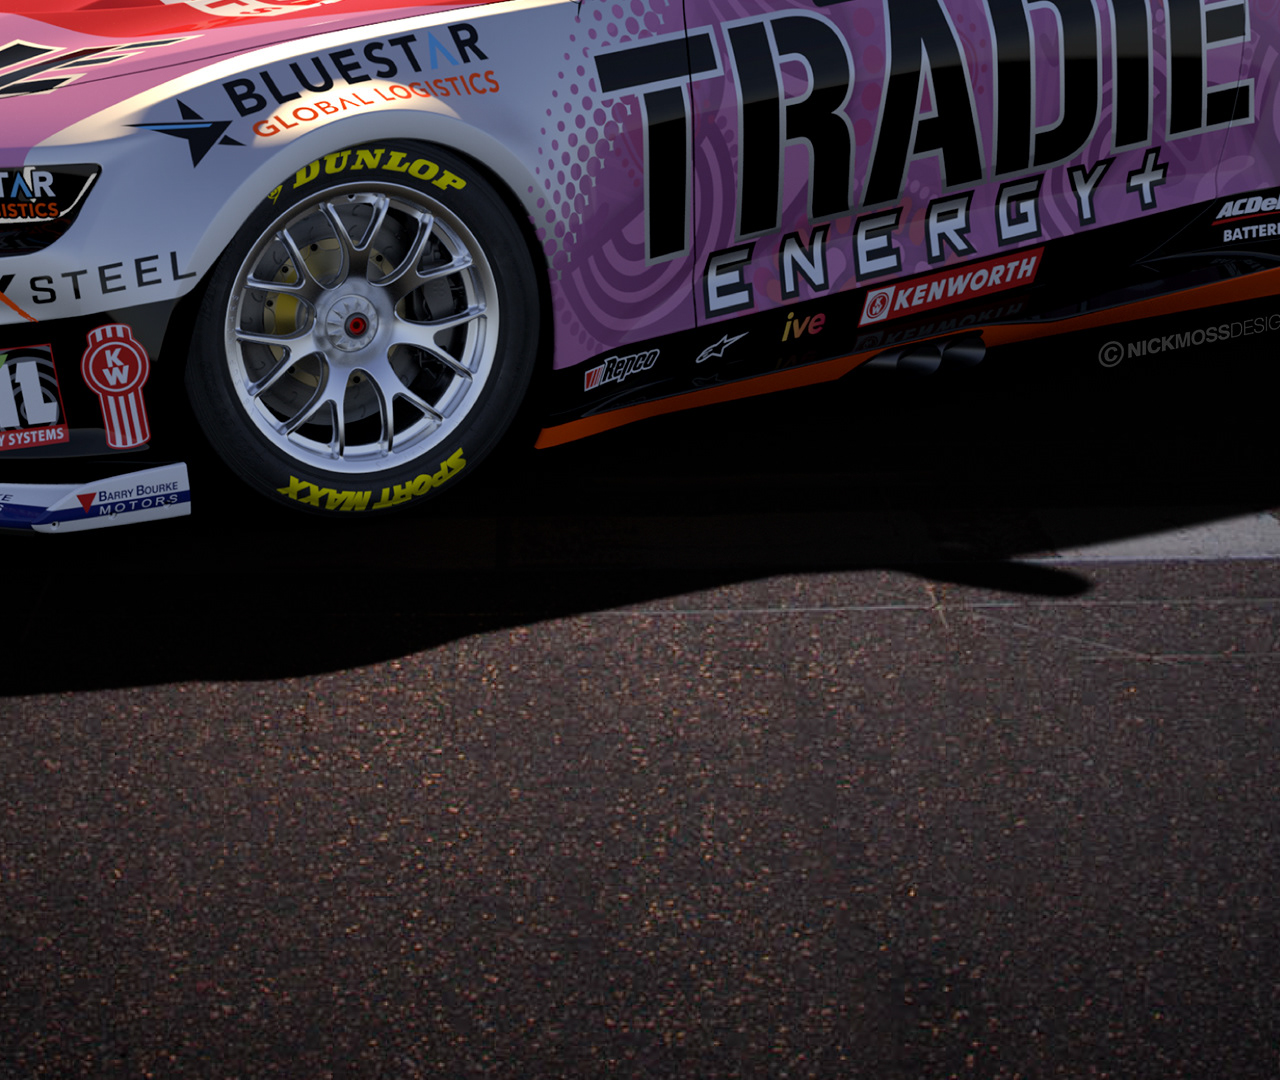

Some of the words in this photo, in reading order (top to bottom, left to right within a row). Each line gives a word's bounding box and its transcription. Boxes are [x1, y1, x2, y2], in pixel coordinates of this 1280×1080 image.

[221, 22, 489, 117] BLUESTAR
[252, 91, 374, 138] GLOBAL
[377, 70, 501, 105] LOGISTICS
[292, 148, 468, 191] DUNLOP
[30, 250, 197, 306] STEEL
[893, 255, 1038, 313] KENWORTH
[781, 311, 826, 342] ive
[601, 348, 660, 383] Repco
[8, 427, 65, 446] SYSTEMS
[98, 488, 134, 503] BARRY
[136, 481, 179, 499] BOURKE
[276, 475, 372, 512] MAXX
[372, 447, 467, 510] SPORT
[99, 494, 179, 516] MOTORS
